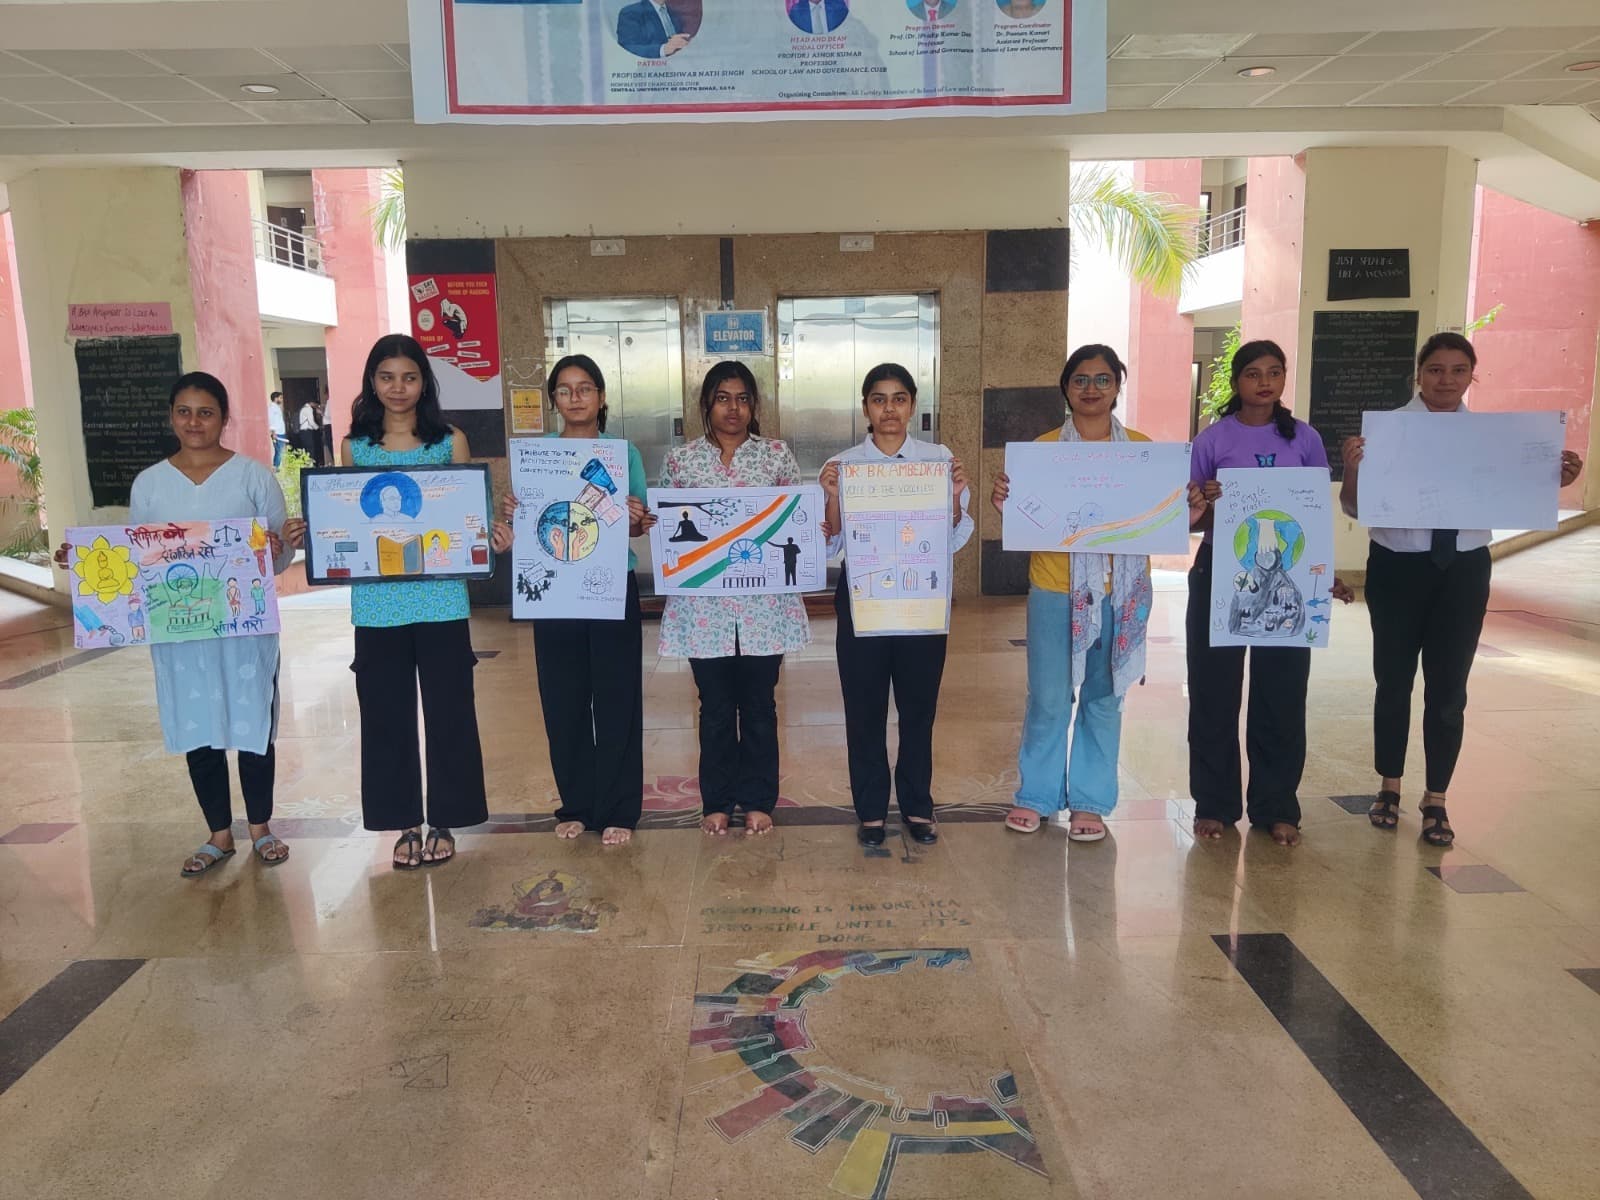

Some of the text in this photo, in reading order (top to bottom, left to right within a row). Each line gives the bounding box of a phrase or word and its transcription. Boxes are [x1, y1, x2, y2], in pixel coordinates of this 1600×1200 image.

[713, 330, 755, 342] ELEVATOR
[519, 449, 549, 457] TRIBUTE
[889, 461, 949, 477] AMBEDKAR
[835, 919, 897, 930] UNTIL
